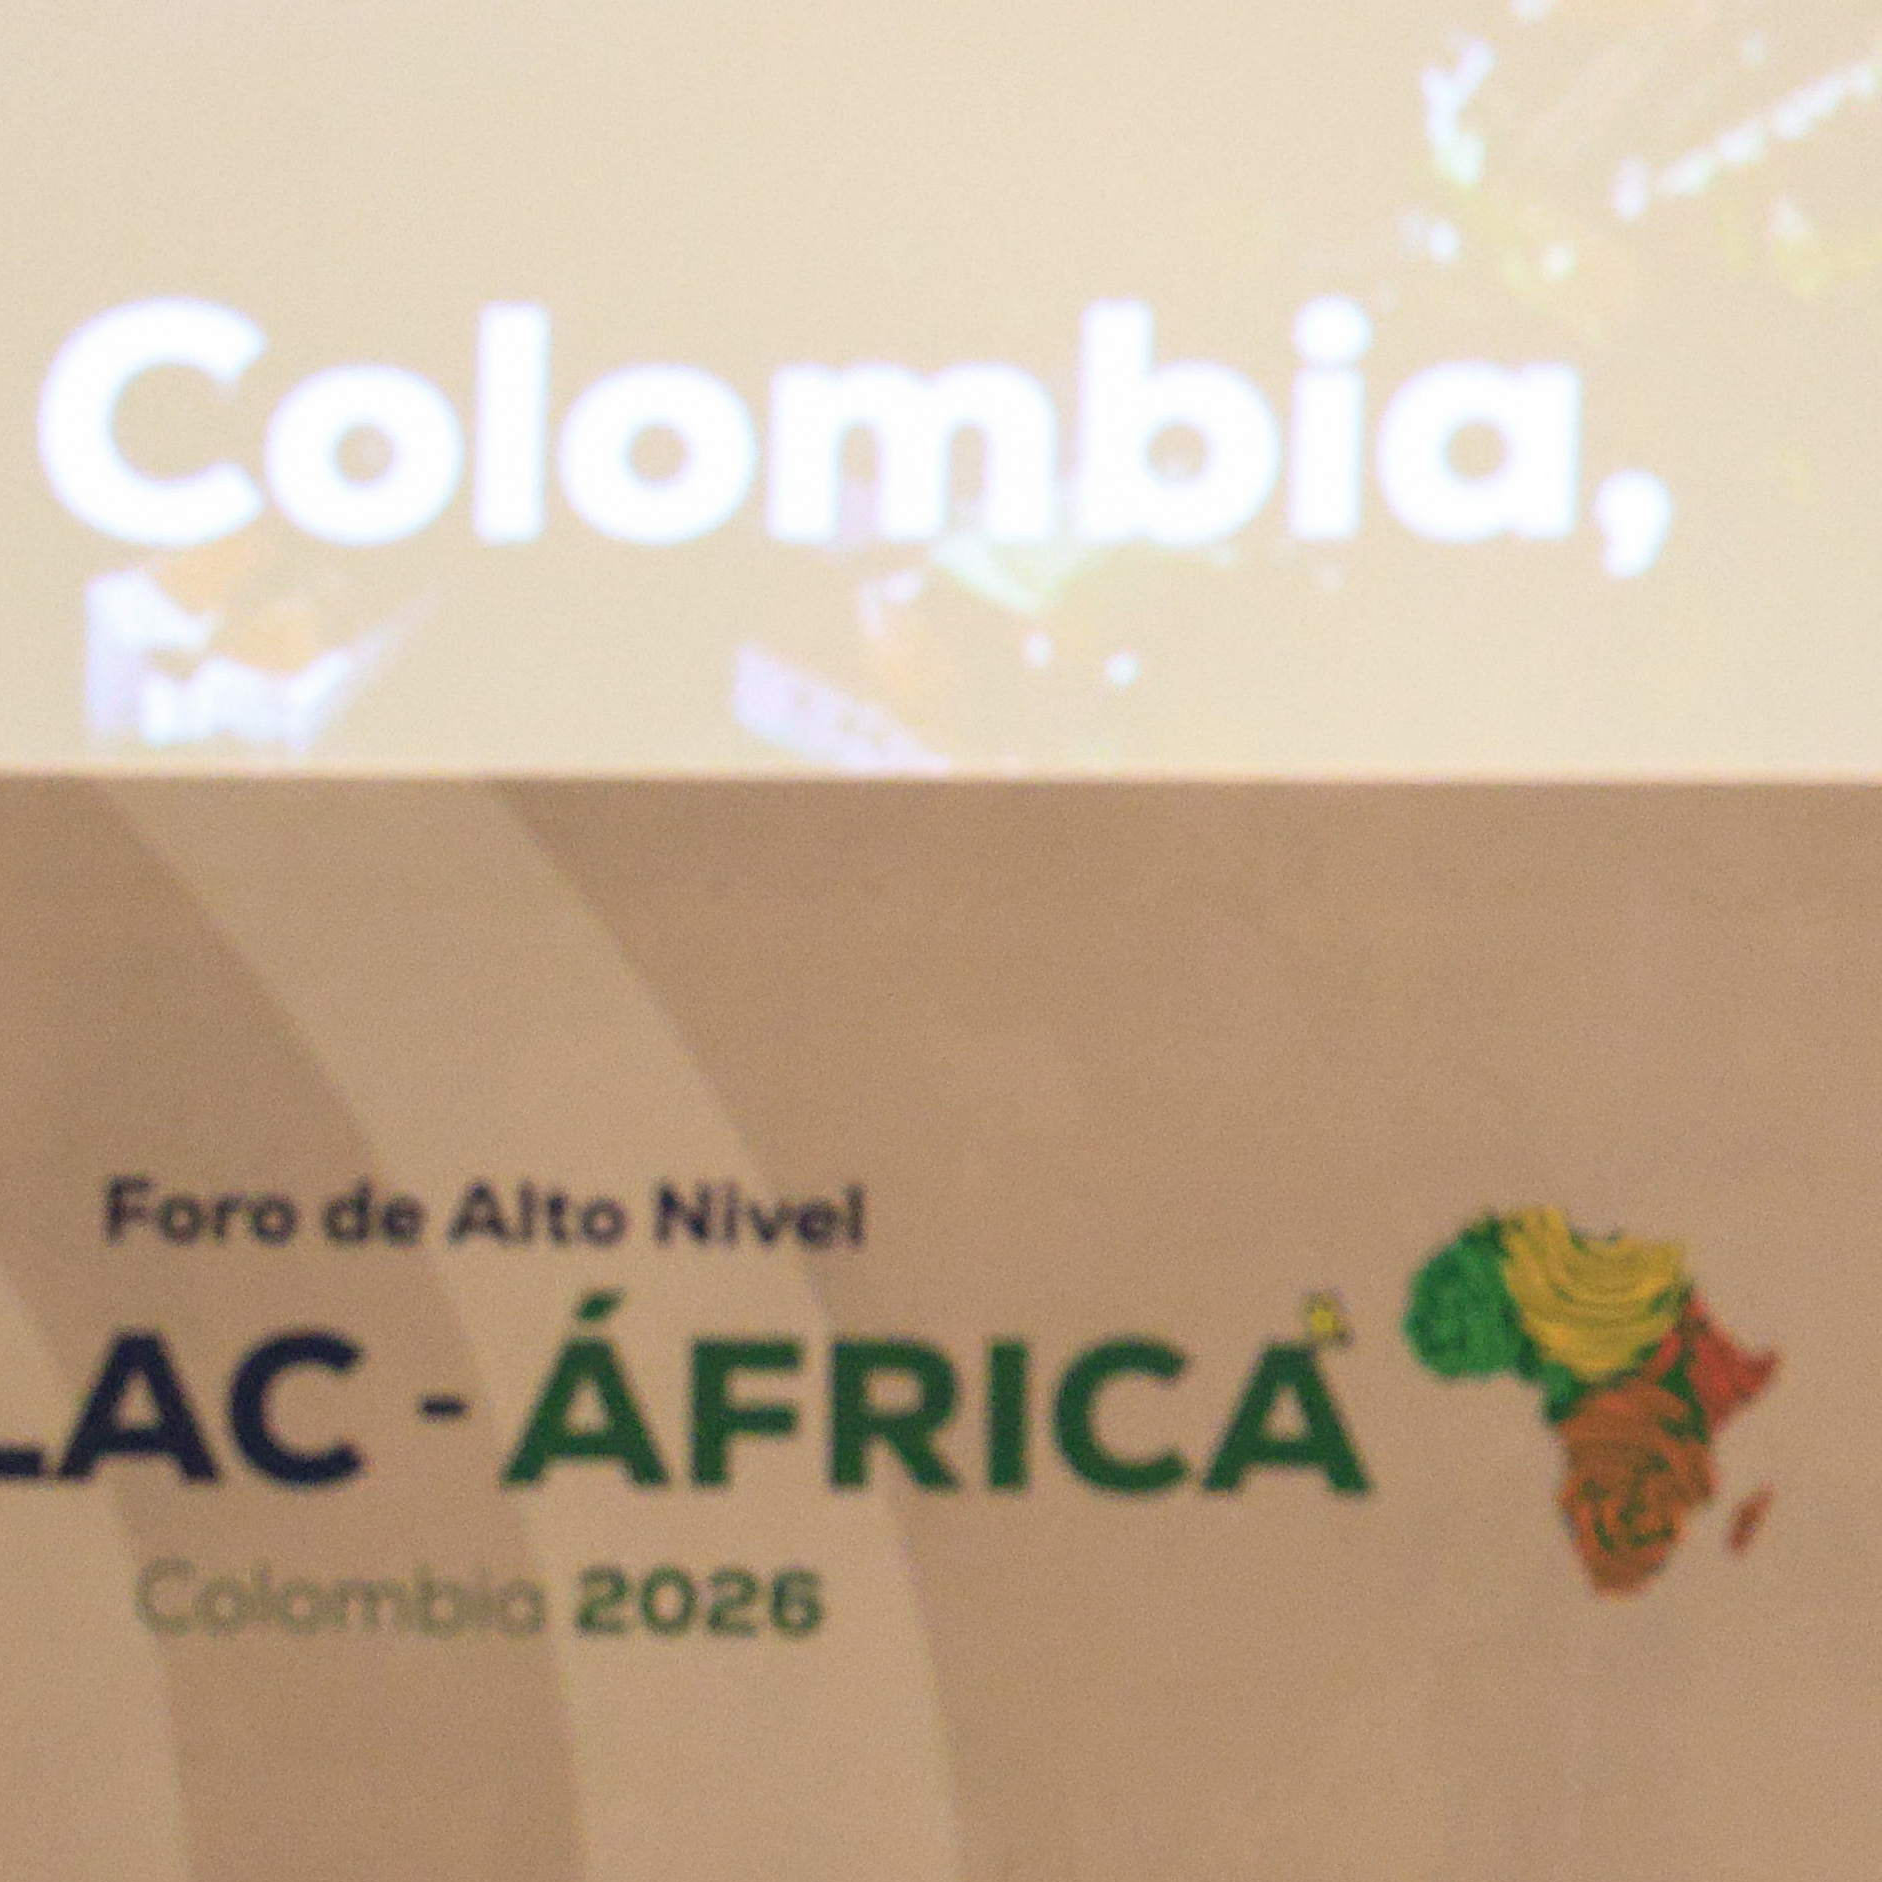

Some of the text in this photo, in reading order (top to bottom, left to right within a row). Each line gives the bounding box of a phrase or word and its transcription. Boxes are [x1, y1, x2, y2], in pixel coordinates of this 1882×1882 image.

[38, 299, 1671, 578] Colombia,
[104, 1174, 866, 1253] Foro de Alto Nivel
[417, 1393, 469, 1423] -
[501, 1289, 1373, 1499] ÁFRICA
[134, 1556, 830, 1645] Colombia 2026
